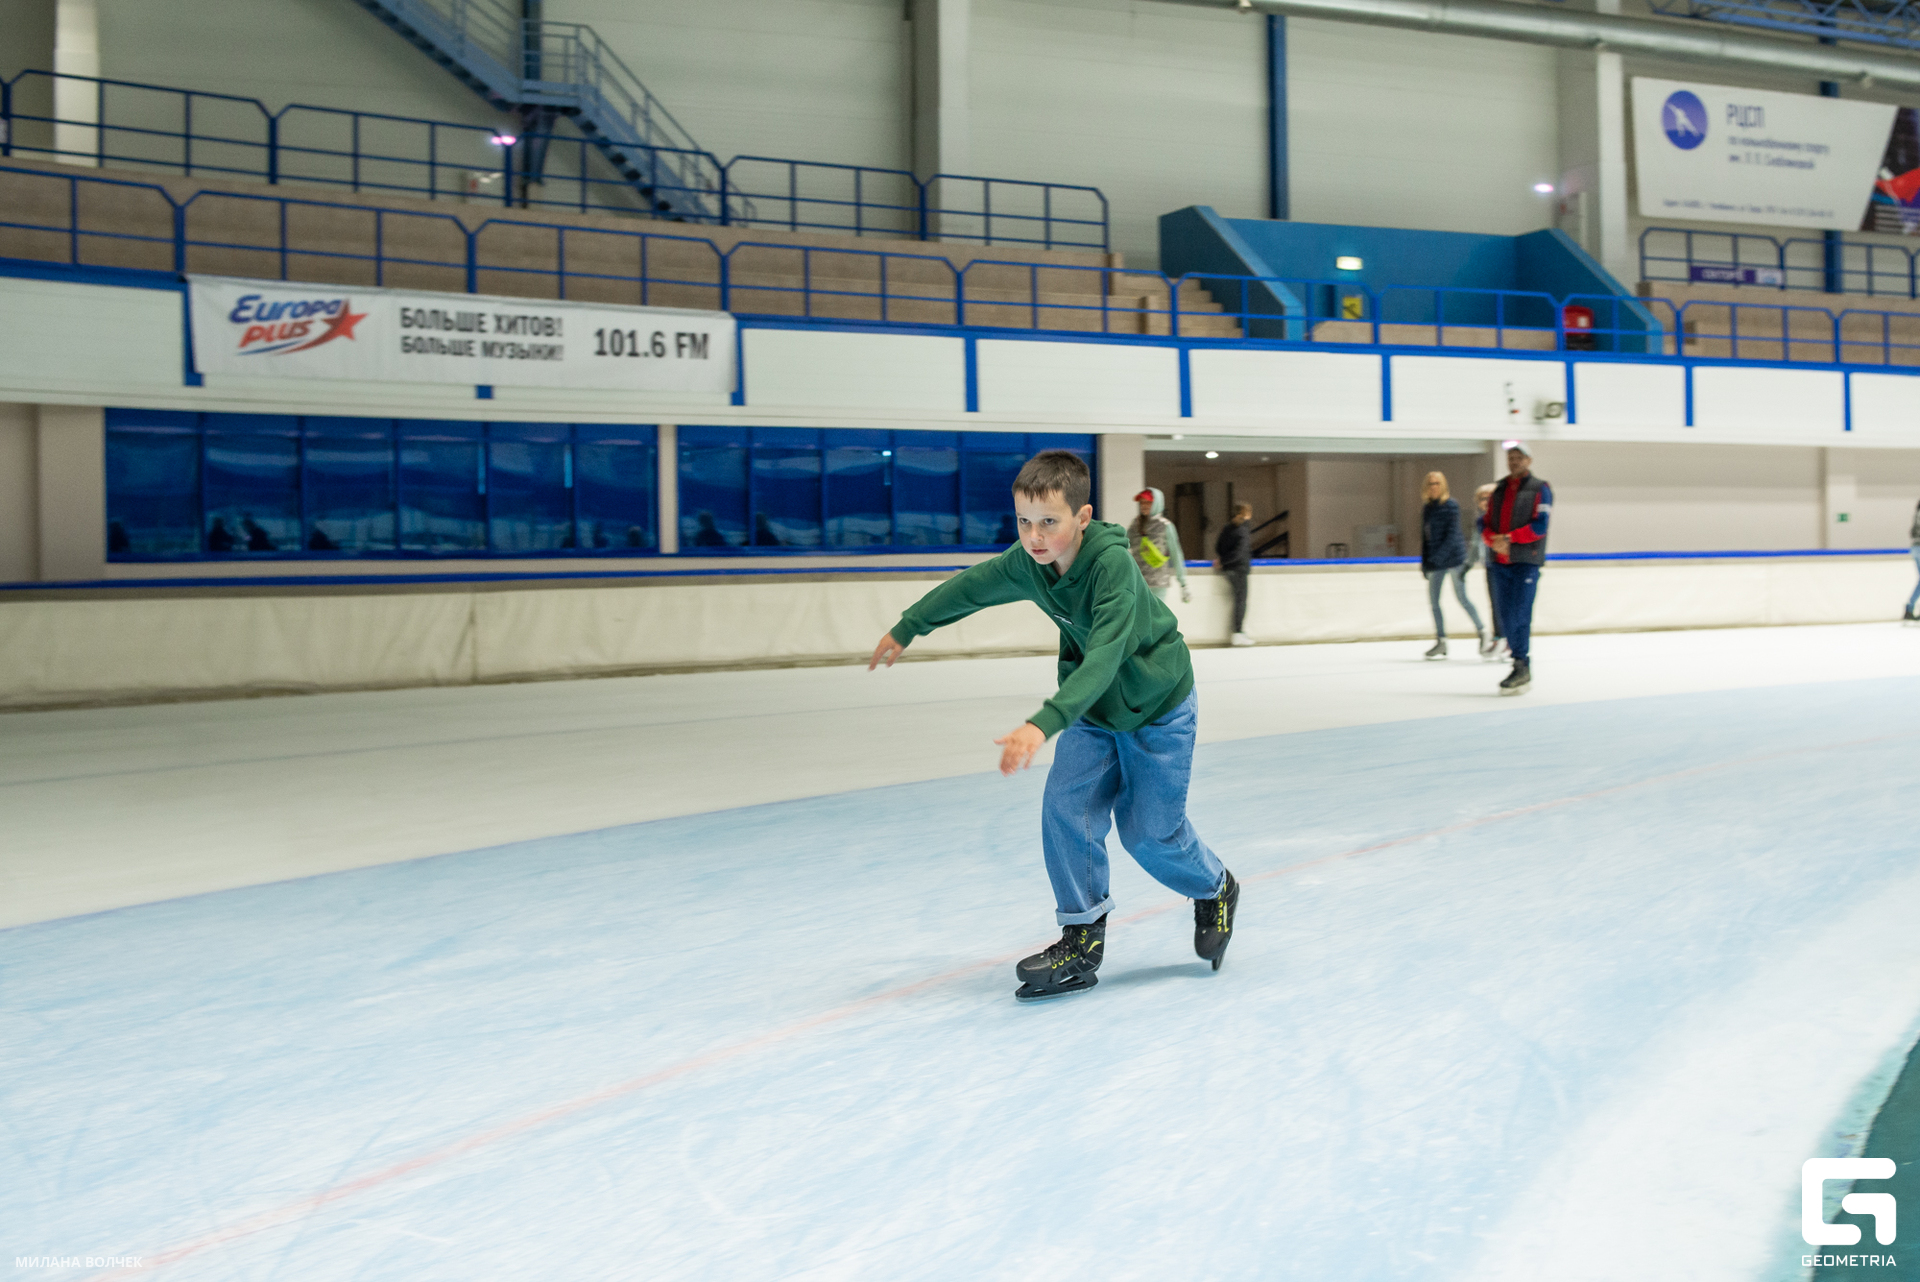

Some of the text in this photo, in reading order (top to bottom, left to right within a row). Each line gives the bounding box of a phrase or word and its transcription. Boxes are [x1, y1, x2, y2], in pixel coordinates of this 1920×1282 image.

[229, 294, 343, 324] Europa
[401, 307, 563, 337] БОЛЬШЕ ХИТОВ!
[401, 336, 564, 361] БОЛЬШЕ МУЗЫКИ!
[594, 328, 709, 360] 101.6 FM
